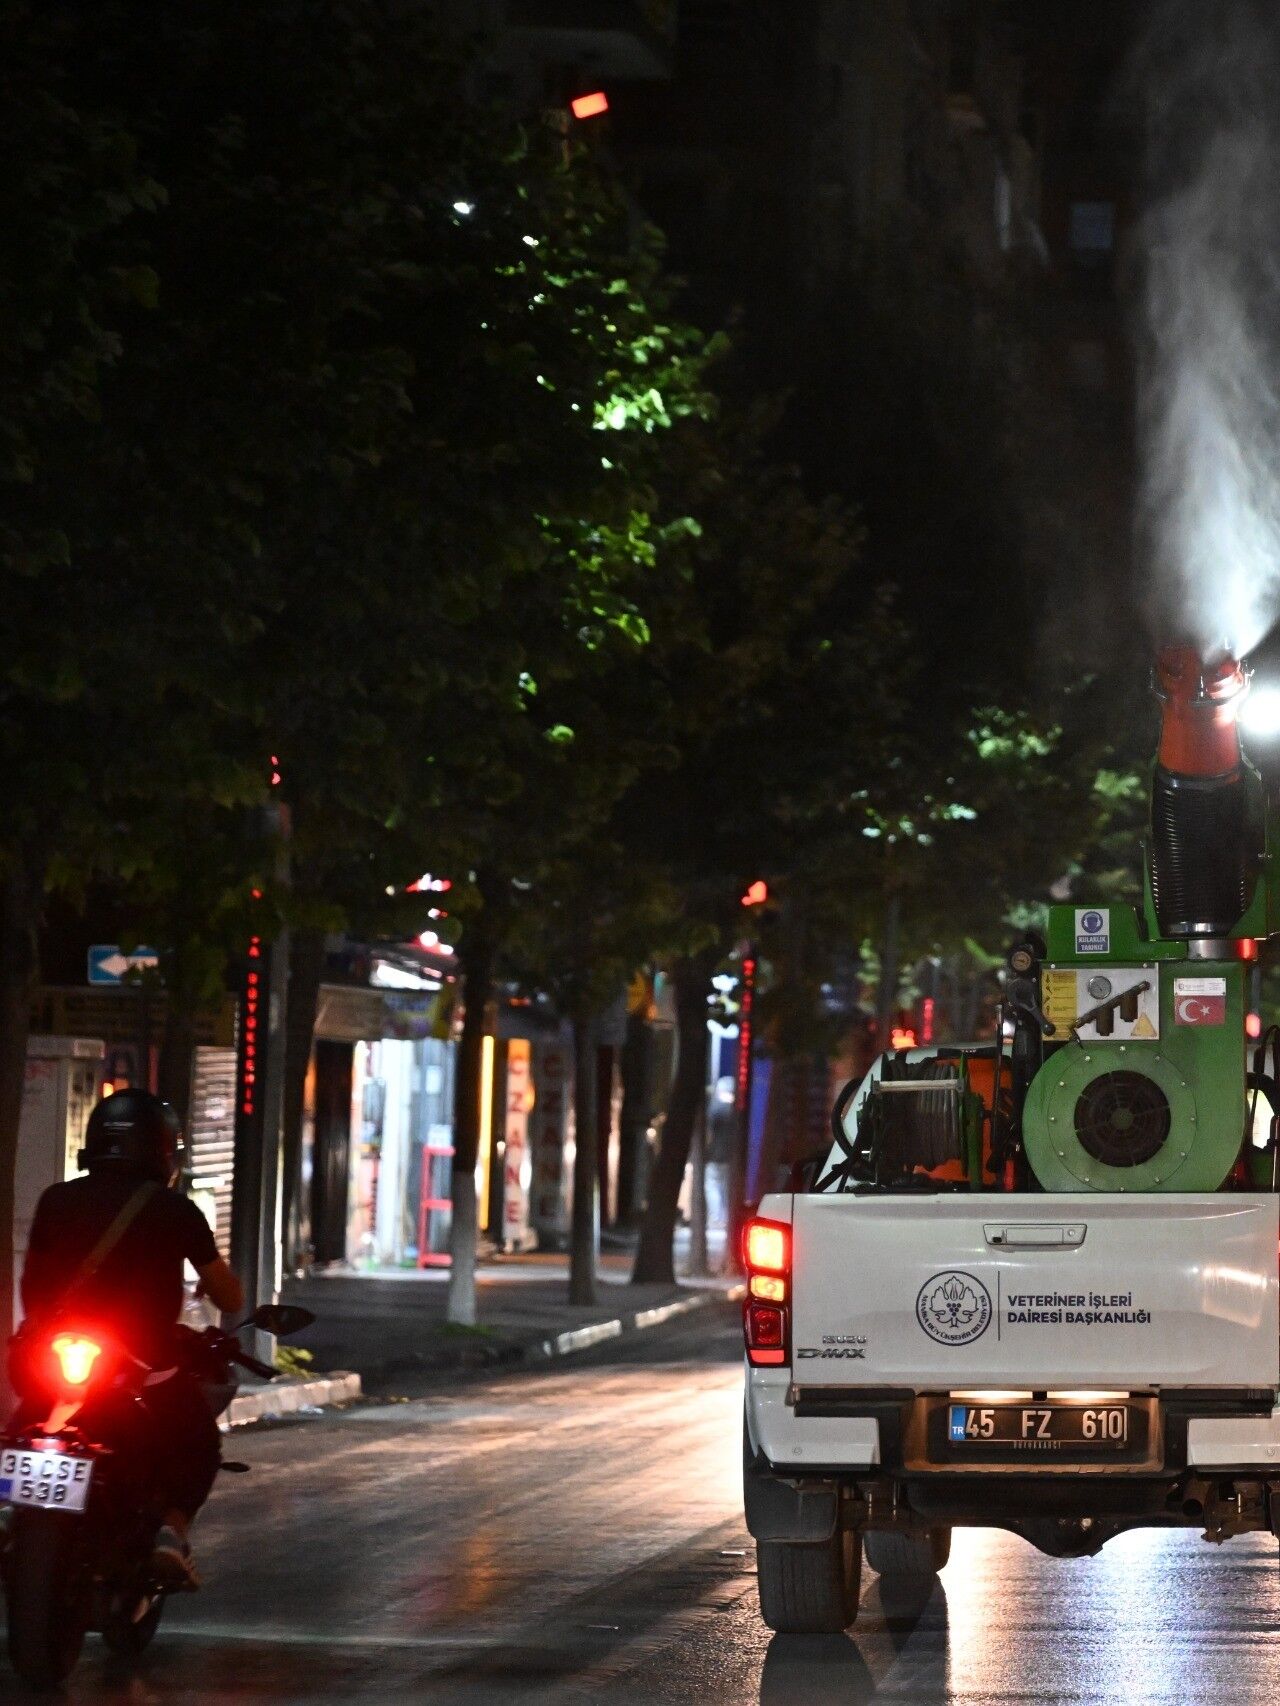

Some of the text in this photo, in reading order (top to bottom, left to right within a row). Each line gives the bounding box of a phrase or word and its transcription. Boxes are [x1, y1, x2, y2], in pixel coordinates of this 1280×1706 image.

[1007, 1291, 1132, 1309] VETERİNER İŞLERİ
[1007, 1308, 1151, 1326] DAİRESİ BAŞKANLIĞI
[822, 1335, 867, 1344] ISUZU
[952, 1409, 1123, 1439] TR 45 FZ 610
[5, 1454, 32, 1476] 35
[21, 1479, 65, 1502] 538
